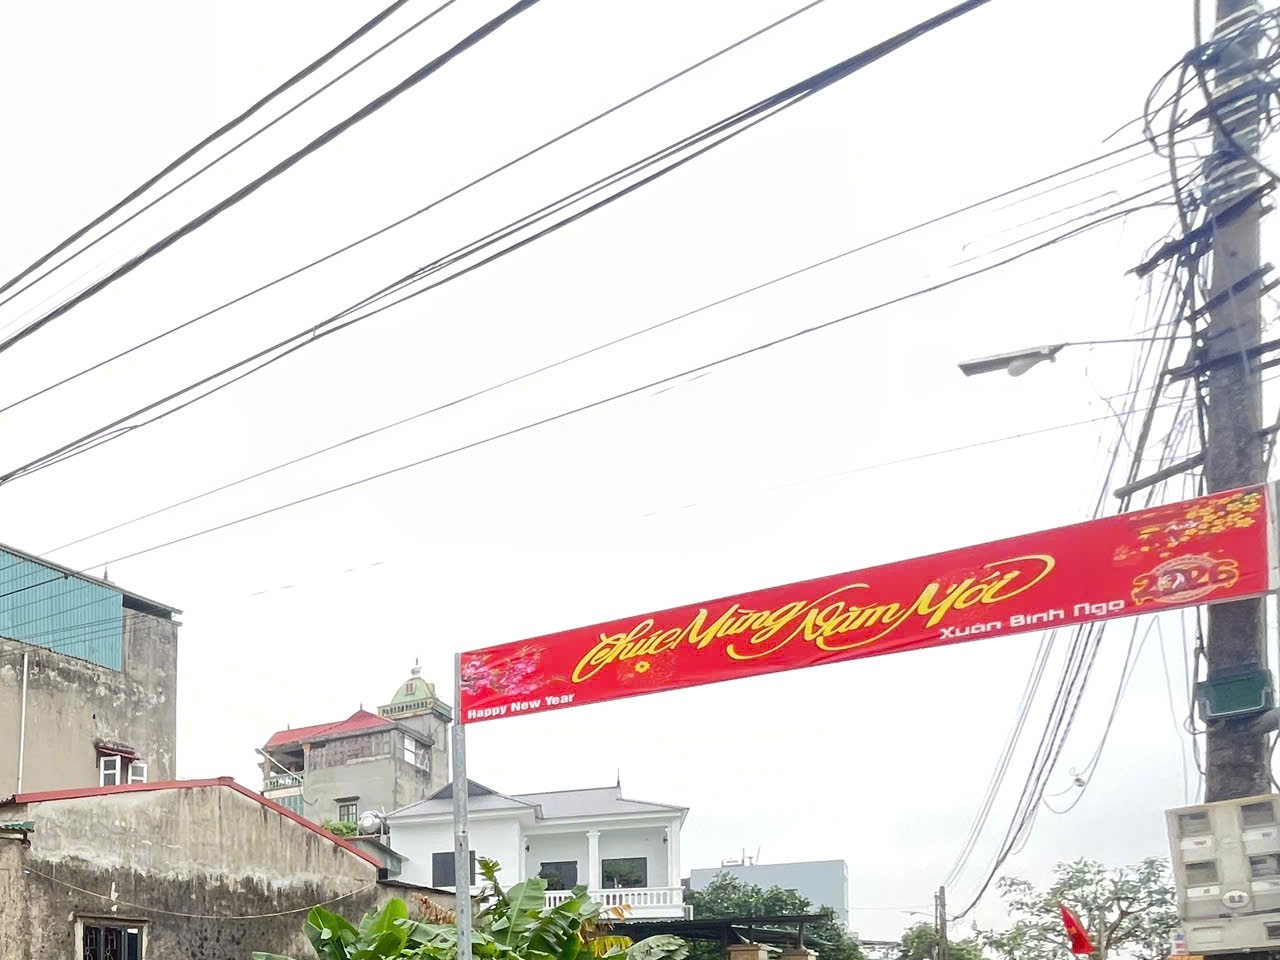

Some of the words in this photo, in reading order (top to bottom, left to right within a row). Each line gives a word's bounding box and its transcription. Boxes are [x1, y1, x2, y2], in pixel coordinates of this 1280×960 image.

[572, 619, 682, 683] Chúc
[768, 583, 906, 653] Năm
[875, 555, 1055, 637] Mới
[939, 621, 1002, 639] Xuân
[1073, 599, 1125, 617] Ngọ
[467, 704, 507, 719] Happy
[510, 699, 542, 712] New
[545, 694, 575, 706] Year
